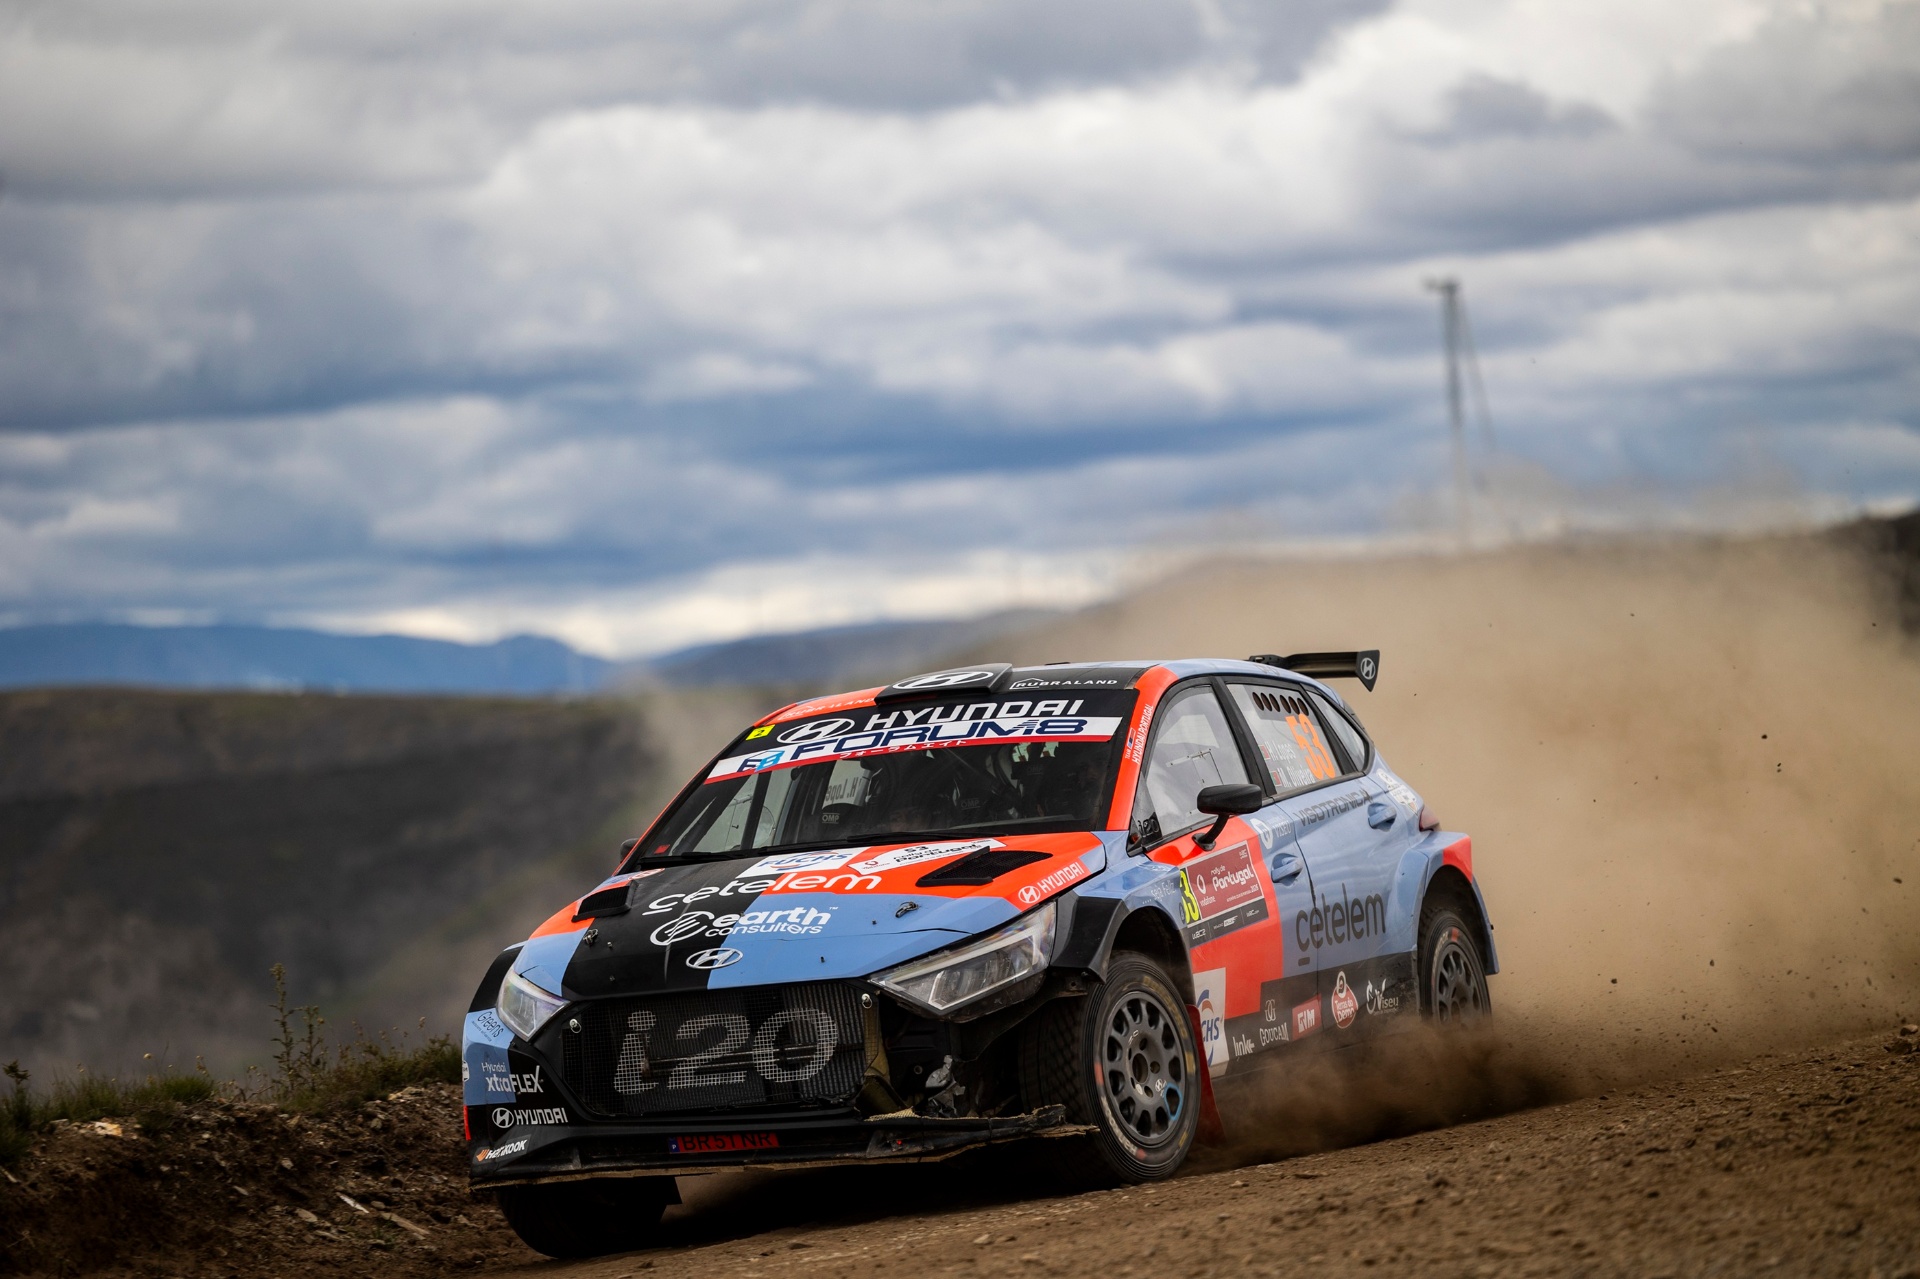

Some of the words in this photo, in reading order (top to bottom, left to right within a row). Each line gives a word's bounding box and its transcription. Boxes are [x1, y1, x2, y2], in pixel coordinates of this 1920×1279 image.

[1016, 679, 1118, 688] RUBRALAND
[863, 700, 1085, 731] HYUNDAI
[789, 719, 1088, 761] FORUM8
[1285, 713, 1336, 780] 53
[821, 814, 840, 823] OMP
[757, 853, 853, 868] FUCHS
[1037, 861, 1085, 894] HYUNDAI
[1212, 864, 1254, 892] Portugal
[644, 872, 882, 914] cetelem
[705, 921, 823, 937] consulters
[712, 907, 832, 928] earth
[1296, 882, 1386, 957] cetelem
[478, 1011, 504, 1038] Greens
[1260, 1022, 1290, 1047] GOUCAM
[613, 1008, 839, 1095] i20
[481, 1062, 507, 1073] Hyundai
[514, 1107, 569, 1125] HYUNDAI
